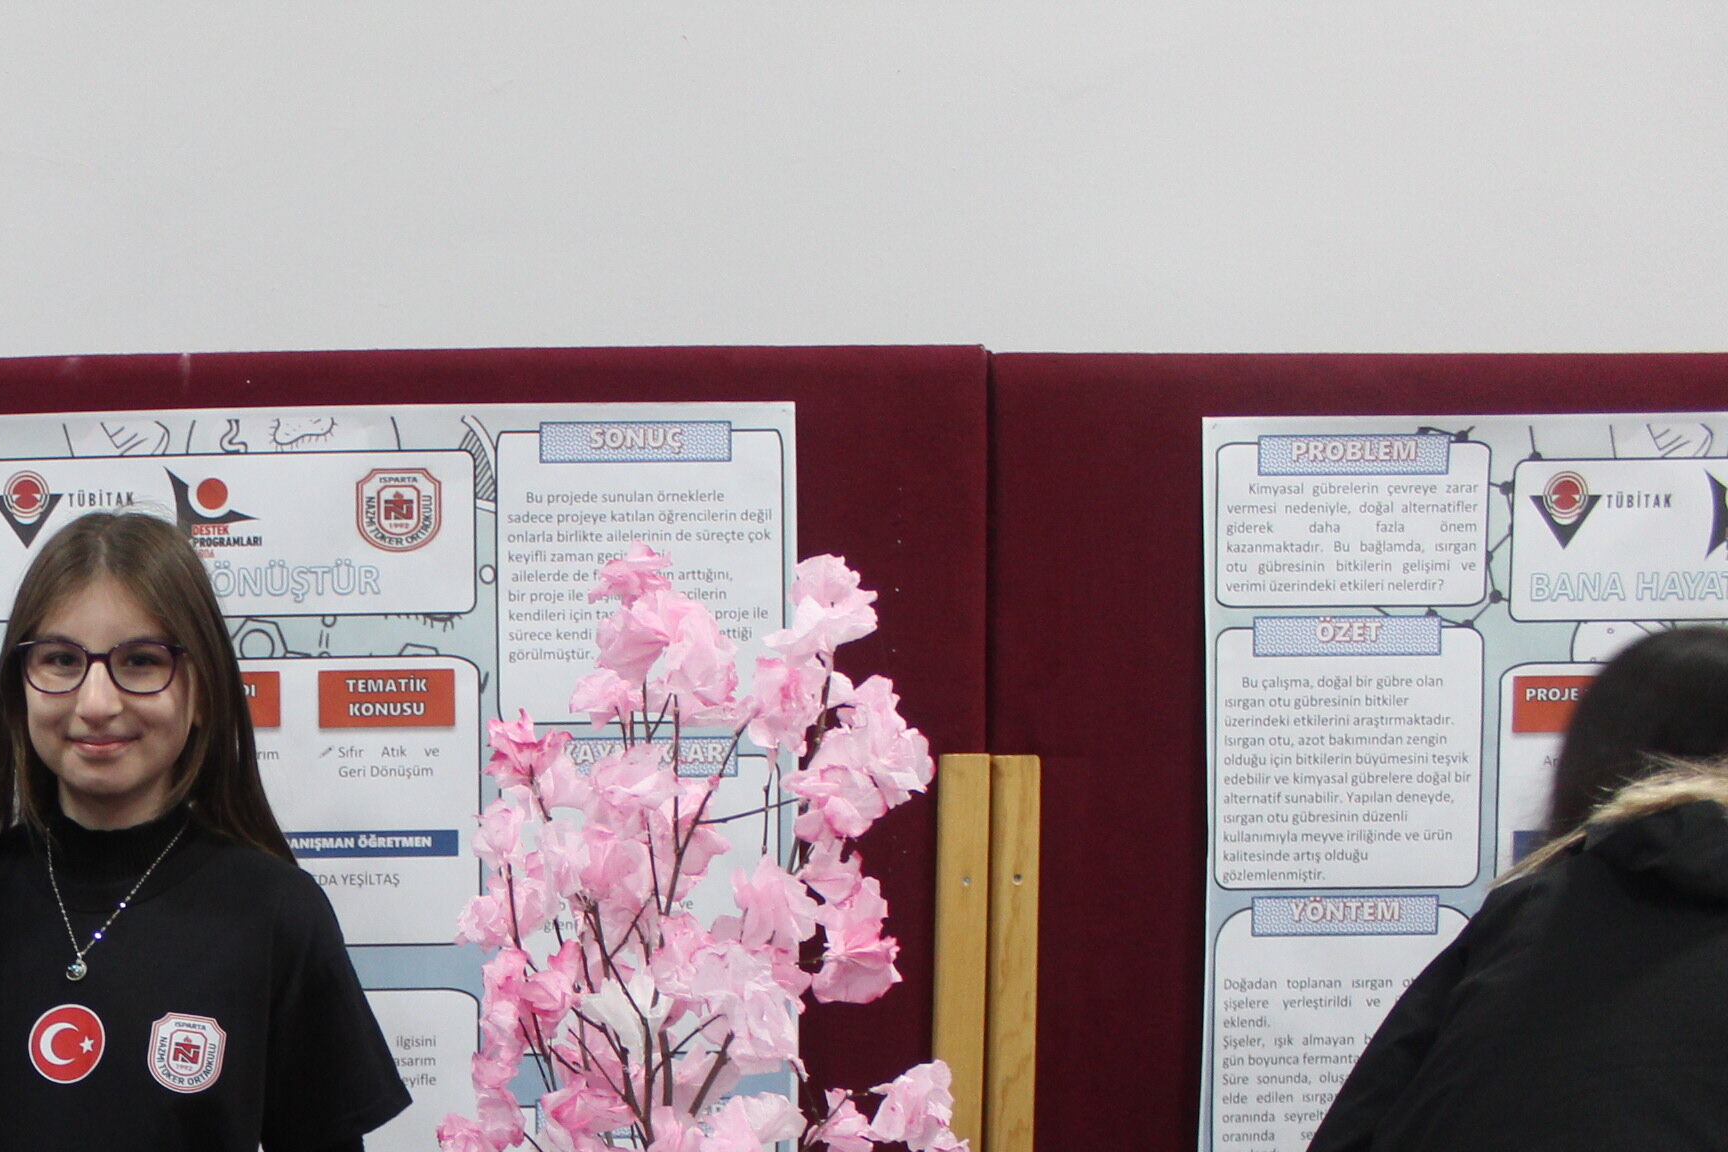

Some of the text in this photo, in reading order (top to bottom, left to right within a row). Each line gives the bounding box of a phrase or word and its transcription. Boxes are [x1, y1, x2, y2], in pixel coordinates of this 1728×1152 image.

[589, 428, 683, 455] SONUÇ
[1291, 440, 1419, 463] PROBLEM
[379, 476, 419, 484] ISPARTA
[526, 489, 725, 506] Bu projede sunulan örneklerle
[1248, 482, 1478, 497] Kimyasal gübrelerin çevreye zarar
[68, 488, 135, 508] TÜBİTAK
[1607, 491, 1673, 509] TÜBİTAK
[1227, 502, 1277, 514] vermesi
[1359, 501, 1394, 516] doğal
[507, 508, 773, 526] sadece projeye katılan öğrencilerin değil
[192, 525, 229, 536] DESTEK
[507, 528, 771, 544] onlarla birlikte ailelerinin de süreçte çok
[1226, 520, 1477, 536] giderek daha fazla önem
[192, 536, 263, 548] PROGRAMLARI
[1334, 540, 1351, 553] Bu
[1435, 542, 1477, 555] ısırgan
[211, 558, 382, 603] ÖNÜŞTÜR
[1530, 571, 1626, 602] BANA
[1315, 617, 1384, 643] ÖZET
[345, 674, 429, 694] TEMATİK
[1242, 676, 1259, 688] Bu
[1317, 675, 1353, 690] doğal
[1356, 675, 1373, 688] bir
[1376, 675, 1413, 690] gübre
[1416, 675, 1444, 687] olan
[1525, 687, 1579, 702] PROJE
[348, 700, 426, 718] KONUSU
[1224, 715, 1290, 727] üzerindeki
[1293, 714, 1350, 727] etkilerini
[338, 745, 440, 759] Sıfır Atık ve
[1224, 752, 1469, 768] olduğu için bitkilerin büyümesini teşvik
[338, 763, 435, 781] Geri Dönüşüm
[1224, 791, 1281, 804] alternatif
[1347, 791, 1393, 806] Yapılan
[288, 833, 433, 853] ANIŞMAN ÖĞRETMEN
[1223, 848, 1369, 864] kalitesinde artış olduğu
[341, 870, 401, 888] YEŞİLTAŞ
[1290, 896, 1401, 922] YÖNTEM
[1224, 977, 1393, 993] Doğadan toplanan ısırgan
[396, 1036, 437, 1050] ilgisini
[394, 1056, 437, 1068] asarım
